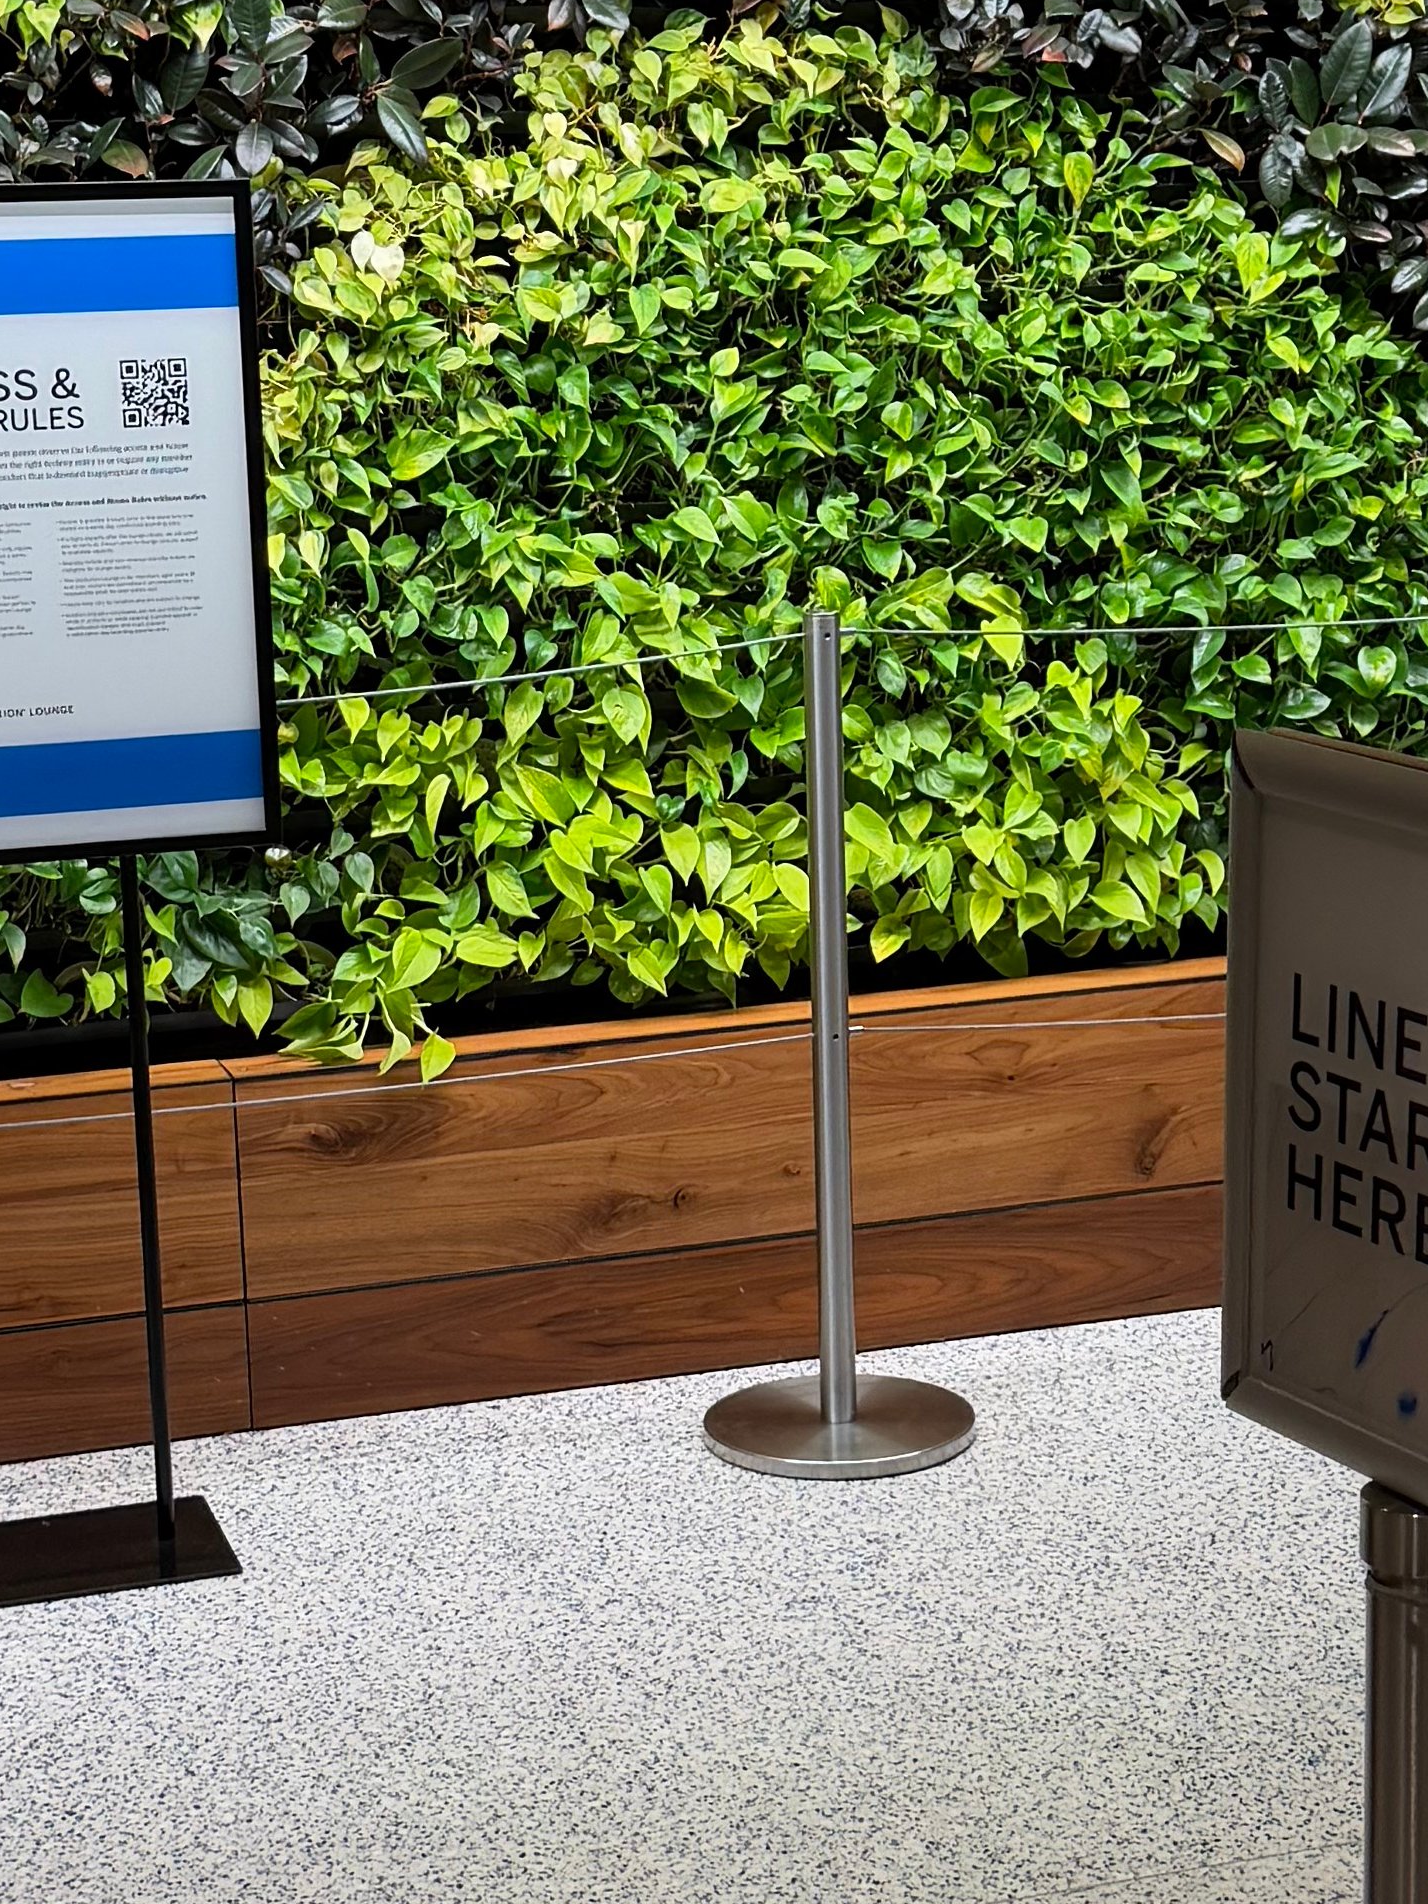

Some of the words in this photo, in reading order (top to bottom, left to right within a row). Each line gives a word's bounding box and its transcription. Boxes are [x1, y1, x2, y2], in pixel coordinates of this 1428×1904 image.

[50, 368, 80, 400] &
[30, 705, 74, 716] LOUNGE
[1289, 971, 1428, 1086] LINE
